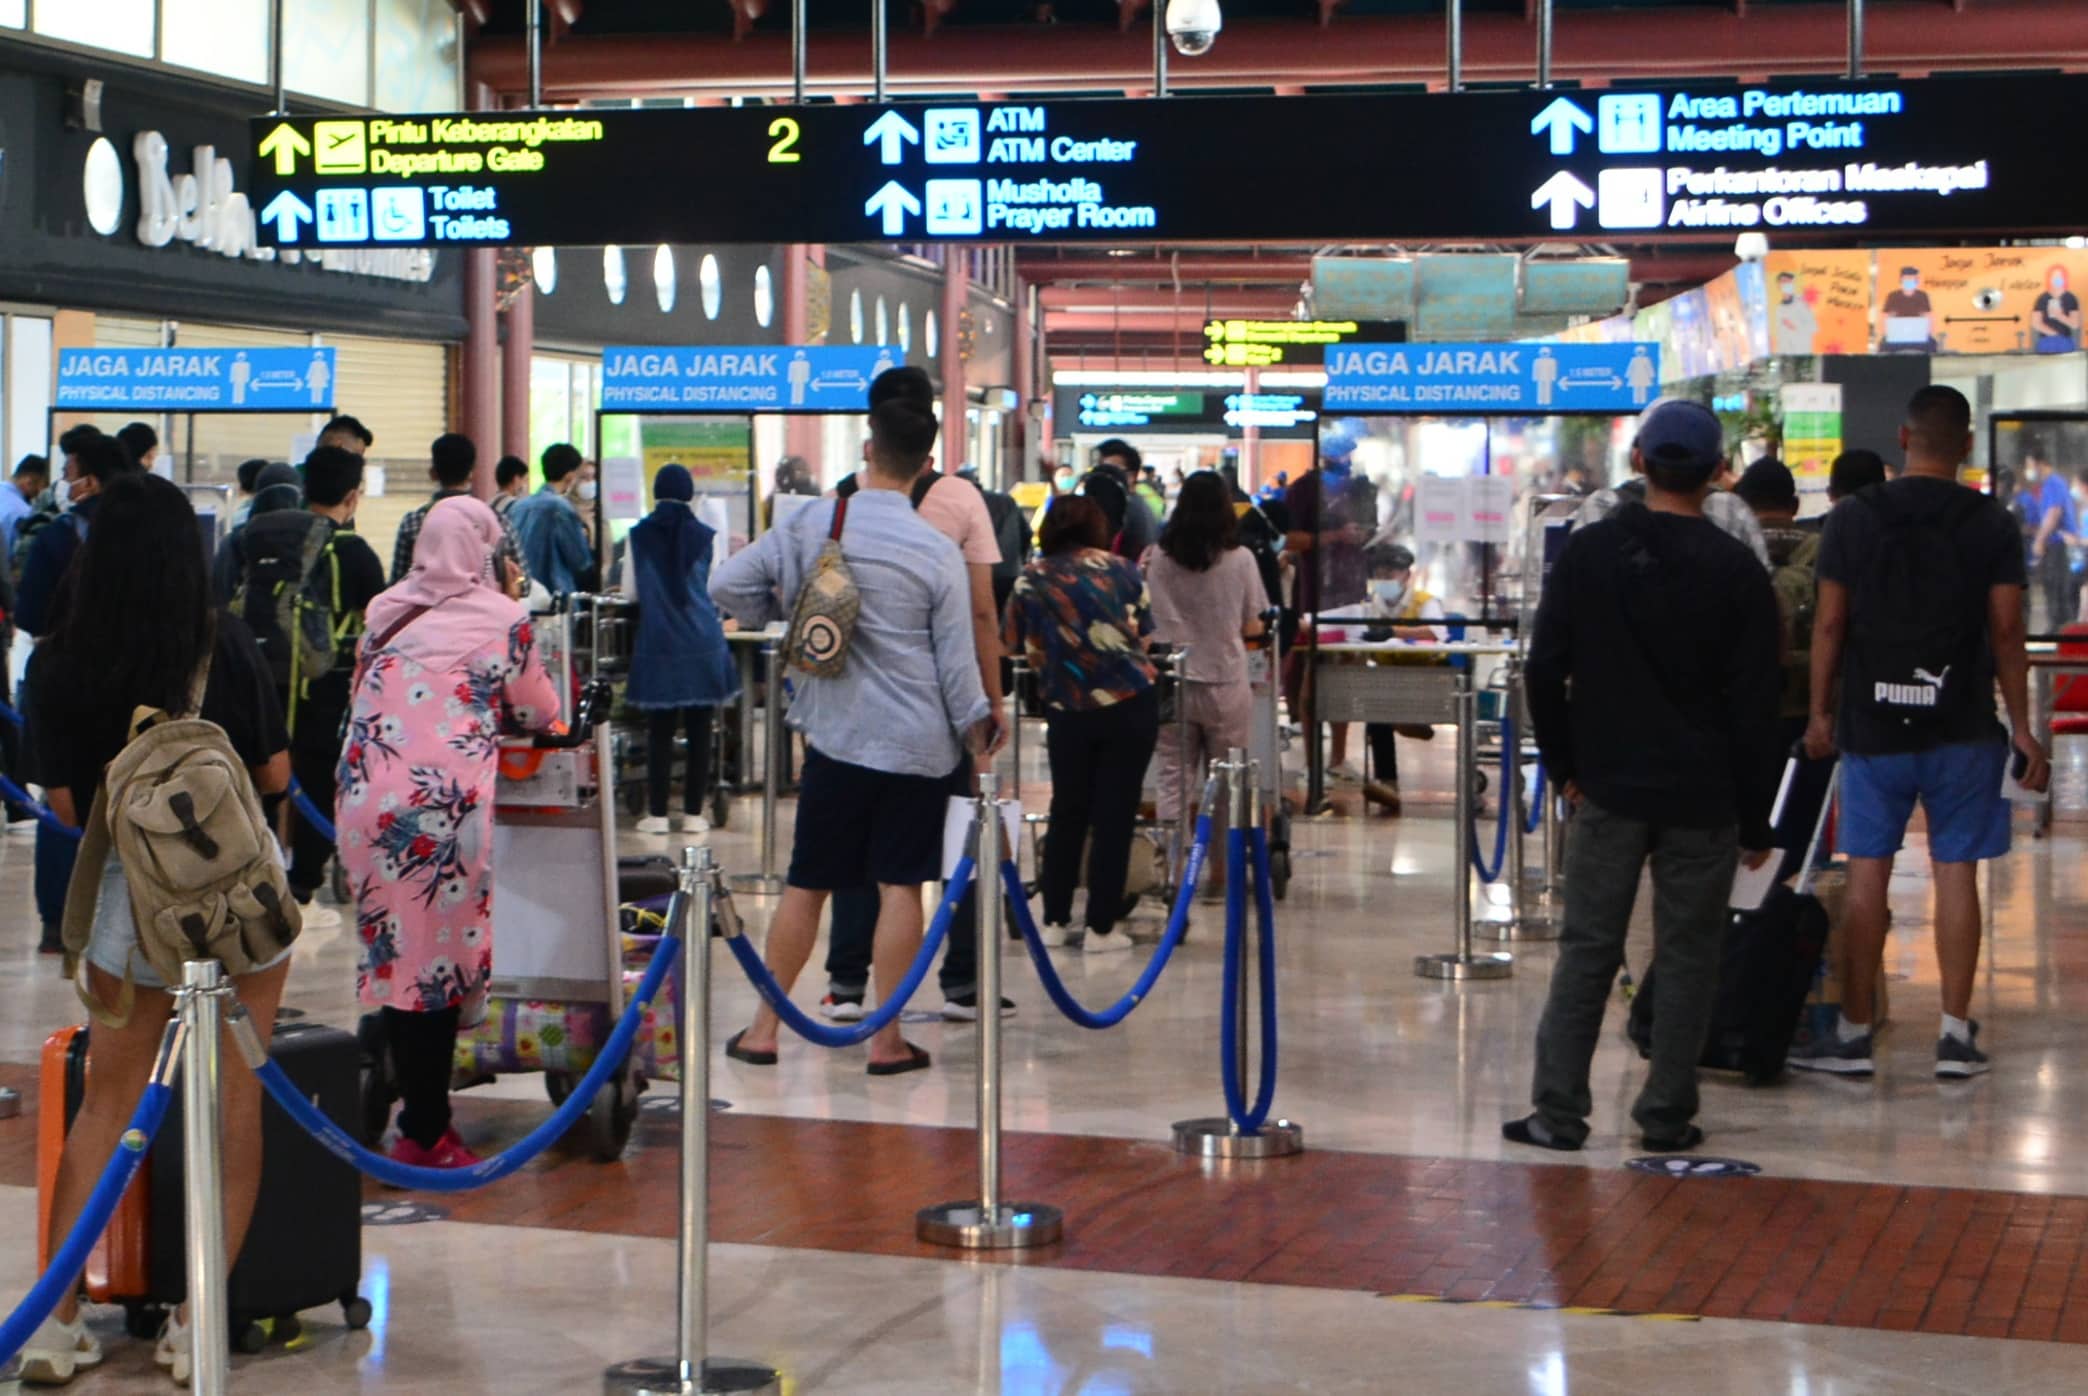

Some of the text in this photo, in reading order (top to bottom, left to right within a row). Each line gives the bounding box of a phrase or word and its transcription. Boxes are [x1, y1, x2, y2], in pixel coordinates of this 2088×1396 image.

[1667, 90, 1903, 119] Area Pertemuan
[369, 117, 604, 147] Pintu Keberangkatan
[986, 106, 1046, 132] ATM
[766, 117, 801, 163] 2
[986, 136, 1138, 163] ATM Center
[1667, 121, 1864, 156] Meeting Point
[370, 147, 545, 179] Departure Gate
[427, 186, 497, 211] Toilet
[986, 177, 1104, 205] Musholla
[987, 203, 1158, 234] Prayer Room
[1667, 195, 1869, 227] Airline Offices
[429, 215, 511, 240] Toilets
[61, 355, 222, 378] JAGA JARAK
[606, 354, 779, 377] JAGA JARAK
[1327, 351, 1521, 375] JAGA JARAK
[58, 385, 221, 401] PHYSICAL DISTANCING
[604, 385, 777, 402] PHYSICAL DISTANCING
[1325, 384, 1521, 401] PHYSICAL DISTANCING
[1874, 681, 1936, 706] PUMA
